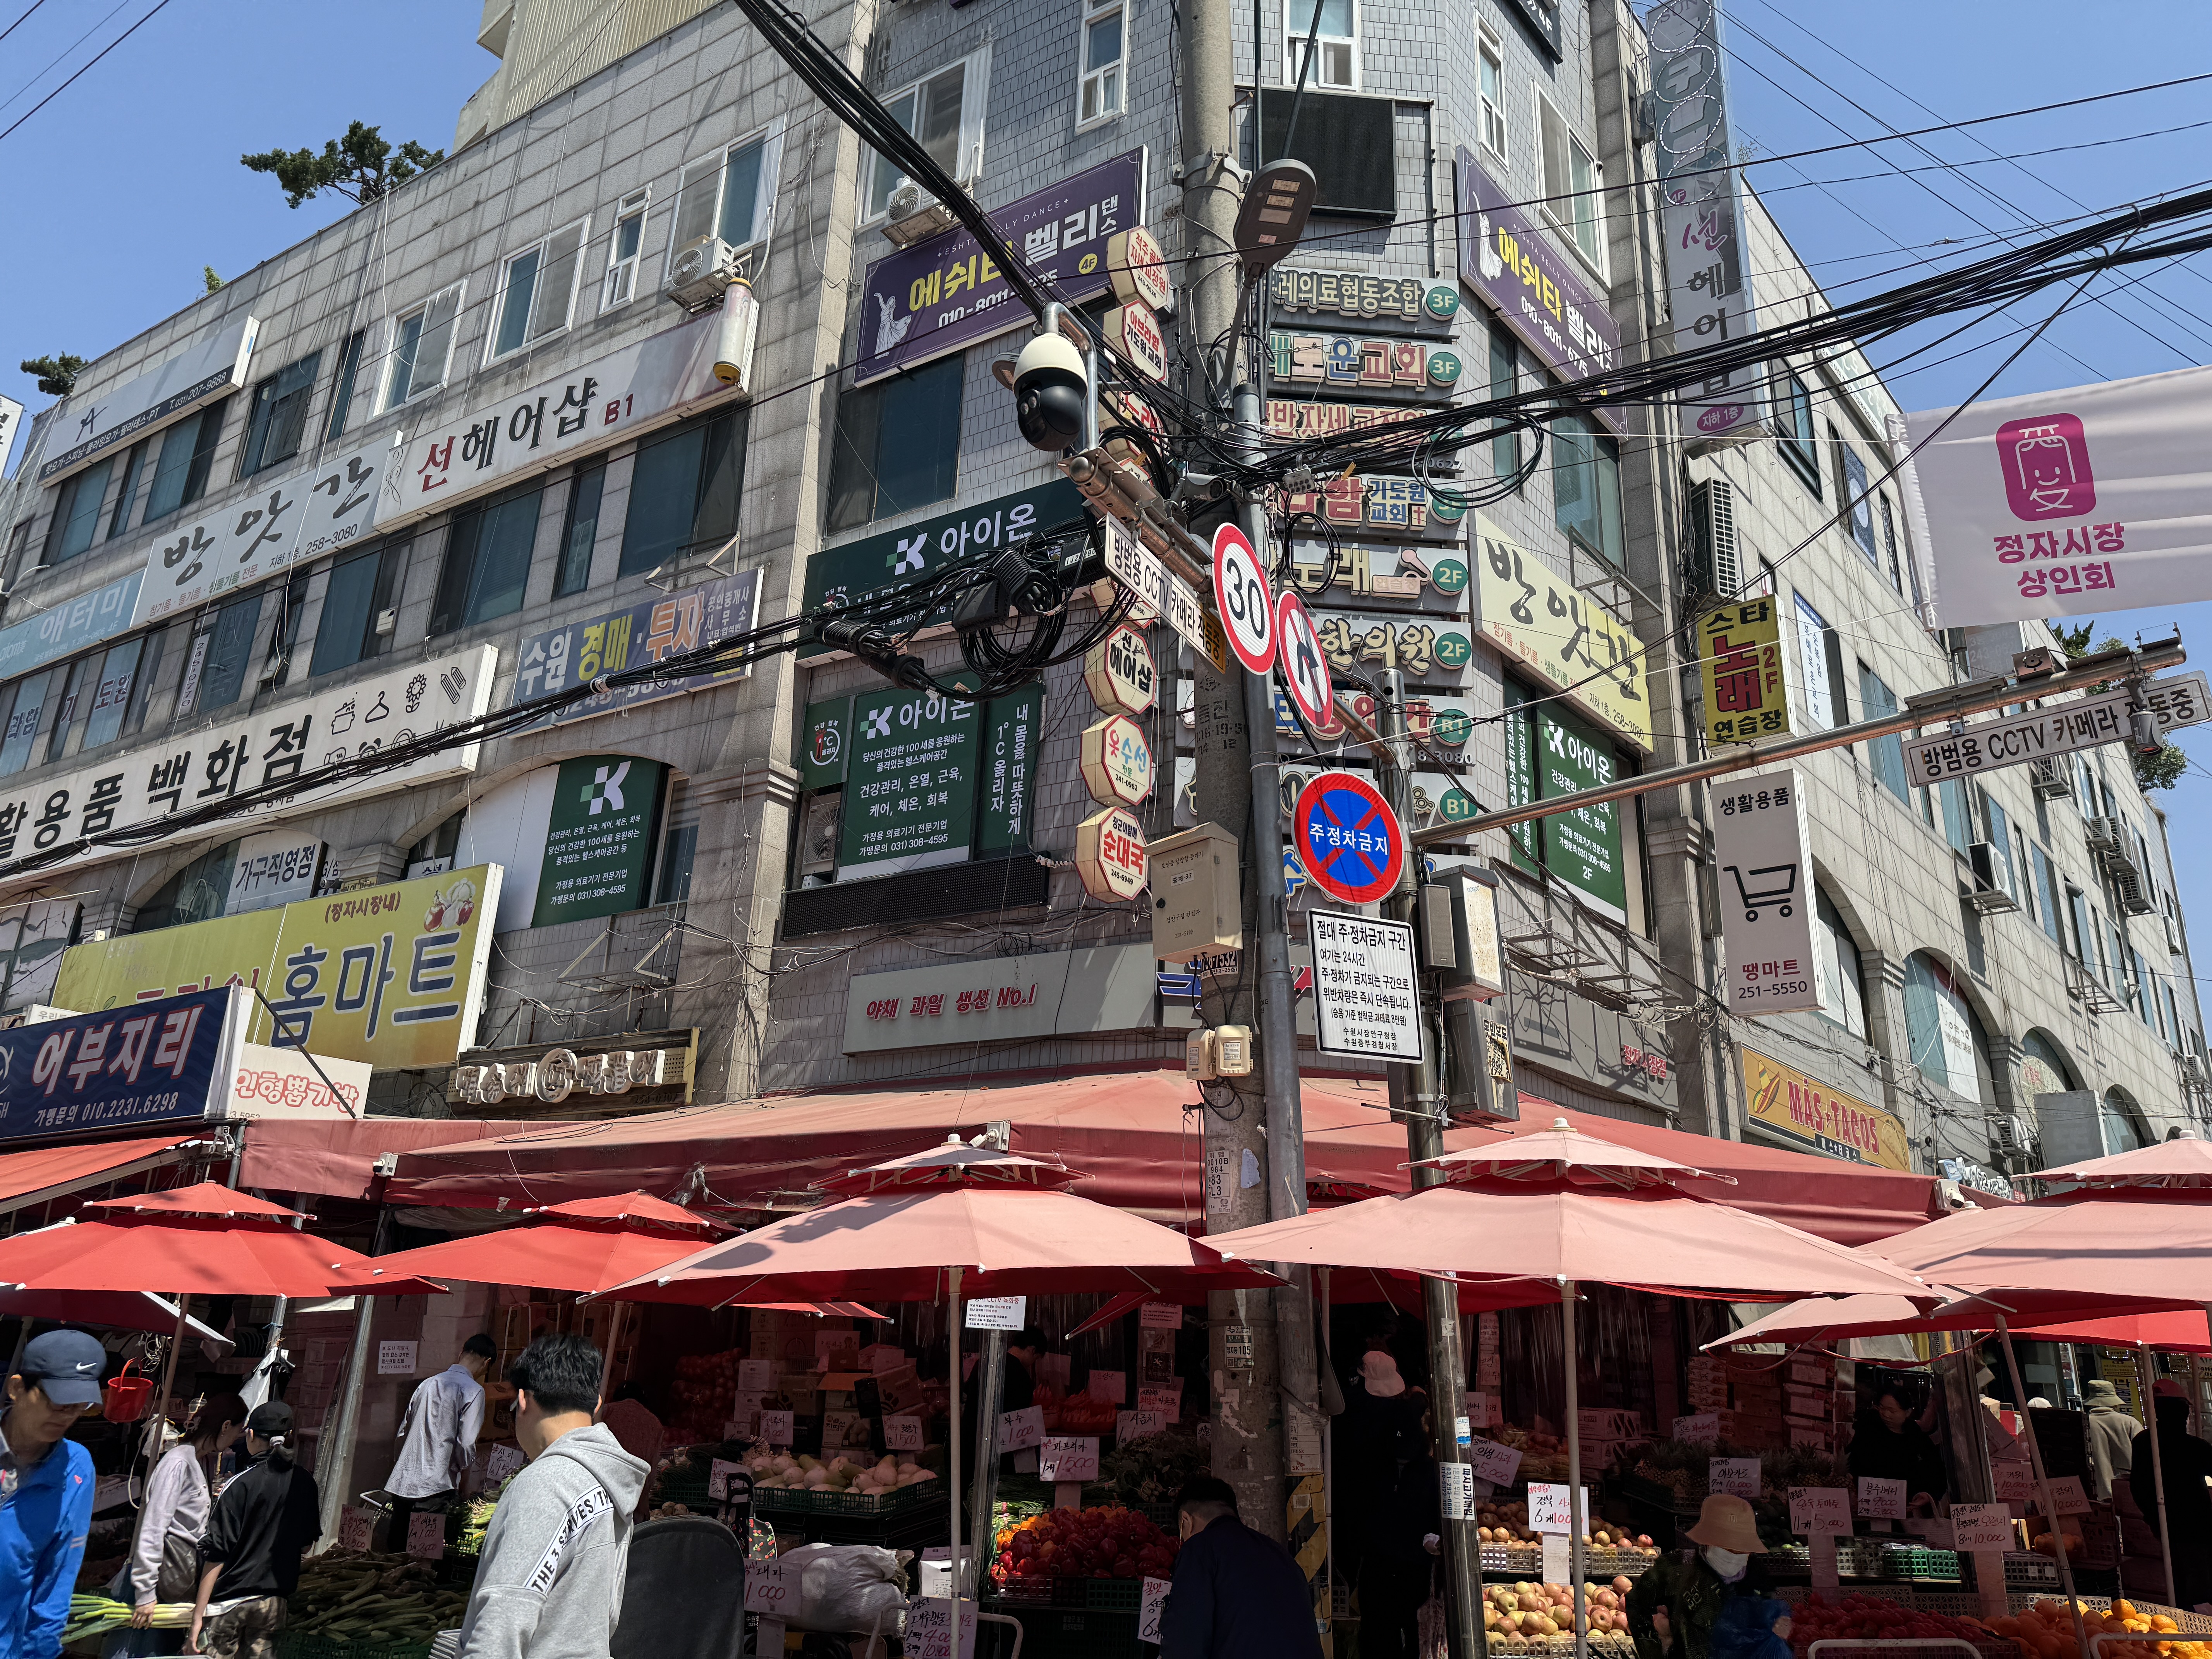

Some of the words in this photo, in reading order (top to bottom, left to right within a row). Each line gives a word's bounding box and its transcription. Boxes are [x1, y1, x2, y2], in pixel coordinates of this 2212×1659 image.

[1024, 201, 1060, 222] DANCE
[1024, 203, 1097, 266] 벨리
[1080, 257, 1096, 271] 4F
[1517, 227, 1539, 256] ESHTA
[1541, 254, 1561, 279] BELLY
[1563, 278, 1583, 303] DANCE
[1432, 294, 1454, 308] 3F
[1498, 226, 1562, 323] 에쉬타
[1566, 299, 1605, 371] 벨리
[1130, 310, 1160, 353] 아브라함
[1127, 323, 1147, 357] 기도원
[1147, 347, 1162, 372] 교회
[1432, 359, 1455, 374] 3F
[604, 393, 634, 426] B1
[1702, 410, 1720, 427] 지하
[1723, 406, 1739, 422] 1층
[1368, 479, 1425, 503] 기도원
[164, 456, 374, 586] 방앗간
[1370, 502, 1407, 522] 교회
[940, 503, 1037, 557] 아이온
[1993, 522, 2126, 564] 정자시장
[269, 553, 285, 568] 지하
[305, 524, 357, 555] 258-3080
[1439, 567, 1462, 583] 2F
[2016, 561, 2116, 599] 상인회
[150, 598, 171, 617] 참기름
[179, 586, 201, 606] 들기름
[242, 563, 258, 580] 전문
[707, 586, 749, 613] 공인중개사
[1114, 533, 1142, 586] 방범용
[1144, 564, 1169, 610] CCTV
[1171, 589, 1195, 637] 카메라
[1198, 614, 1220, 661] 작동중
[1226, 557, 1265, 639] 30
[40, 580, 130, 644] 애터미
[1485, 538, 1642, 702] 방앗간
[1705, 601, 1770, 635] 스타
[521, 632, 572, 696] 수원
[578, 613, 633, 681] 경매
[646, 591, 705, 661] 투자
[1123, 632, 1132, 653] 선
[1318, 619, 1435, 675] 한의원
[1441, 641, 1465, 656] 2F
[1110, 644, 1152, 694] 헤어샵
[1519, 641, 1539, 665] 들기름
[1544, 659, 1568, 687] 생들기름
[1712, 634, 1763, 713] 노래
[899, 697, 974, 730] 아이온
[1016, 703, 1029, 721] 내
[1589, 692, 1600, 710] 지하
[1613, 709, 1644, 741] 258-3080
[1714, 709, 1782, 740] 연습장
[862, 749, 883, 763] 당신의
[884, 745, 905, 759] 건강한
[936, 733, 965, 747] 응원하는
[1013, 724, 1027, 760] 몸을
[1108, 729, 1146, 773] 옷수선
[1920, 737, 1982, 776] 방범용
[1987, 722, 2045, 760] CCTV
[2054, 704, 2121, 745] 카메라
[147, 714, 312, 812] 백화점
[876, 758, 905, 773] 품격있는
[905, 749, 948, 767] 헬스케어공간
[1568, 736, 1612, 785] 아이온
[860, 777, 904, 799] 건강관리,
[908, 773, 933, 789] 온열,
[938, 766, 963, 782] 근육,
[991, 759, 1006, 812] 올리자
[1115, 774, 1138, 792] 241-0962
[1520, 773, 1529, 785] 100
[869, 800, 893, 818] 케어,
[898, 796, 922, 812] 체온,
[926, 791, 948, 807] 회복
[1008, 763, 1025, 835] 따뜻하게
[1447, 799, 1469, 814] B1
[1719, 787, 1790, 816] 생활용품
[550, 829, 571, 840] 건강관리,
[573, 826, 585, 836] 온열,
[587, 823, 599, 833] 근육,
[601, 820, 613, 830] 케어,
[615, 817, 628, 827] 체온,
[630, 814, 641, 824] 회복
[862, 830, 884, 844] 가정용
[886, 824, 915, 839] 의료기기
[917, 819, 948, 834] 전문기업
[1113, 816, 1138, 840] 장군이할매
[1309, 823, 1388, 856] 주정차금지
[1594, 816, 1607, 836] 회복
[548, 843, 567, 855] 당신의
[568, 839, 586, 850] 건강한
[588, 833, 613, 846] 100세를
[615, 829, 640, 842] 응원하는
[556, 854, 579, 866] 품격있는
[582, 845, 619, 861] 헬스케어공간
[621, 844, 627, 854] 등
[859, 844, 888, 858] 가맹문의
[1103, 830, 1144, 876] 순대국
[1559, 823, 1573, 840] 가정용
[1573, 830, 1592, 850] 의료기기
[1592, 841, 1609, 860] 전문기업
[1559, 837, 1577, 859] 가맹문의
[235, 843, 316, 891] 가구직영점
[555, 878, 574, 890] 가정용
[575, 874, 601, 887] 의료기기
[602, 869, 628, 882] 전문기업
[1111, 869, 1134, 885] 245-6949
[1582, 865, 1593, 880] 2F
[325, 891, 401, 924] (정자시장내)
[550, 893, 575, 905] 가맹문의
[1317, 920, 1336, 941] 절대
[1338, 923, 1386, 948] 주·정차금지
[1388, 931, 1406, 951] 구간
[1320, 948, 1341, 963] 여기는
[1343, 950, 1365, 966] 24시간
[1742, 958, 1801, 982] 땡마트
[268, 929, 463, 1050] 홈마트
[1321, 967, 1352, 984] 주·정차가
[1353, 971, 1381, 988] 금지되는
[1382, 975, 1410, 990] 구간으로
[1738, 980, 1808, 1000] 251-5550
[866, 997, 902, 1020] 야채
[909, 993, 947, 1016] 과일
[955, 988, 992, 1013] 생선
[996, 983, 1039, 1008] No.1
[1323, 986, 1358, 1004] 위반차량은
[1360, 991, 1374, 1006] 즉시
[1375, 994, 1411, 1011] 단속됩니다.
[1331, 1007, 1344, 1019] (승용
[1345, 1009, 1356, 1020] 기준
[1391, 1014, 1407, 1027] 8만원)
[32, 1003, 206, 1097] 어부지리
[1623, 1044, 1667, 1079] 정자시장점
[235, 1068, 359, 1114] 인형뽑기방
[34, 1104, 79, 1127] 가맹문의
[82, 1091, 179, 1121] 010.2231.6298
[1829, 1098, 1879, 1156] TACOS
[1239, 1345, 1251, 1355] 105
[1005, 1412, 1024, 1426] 부추
[1130, 1412, 1156, 1426] 시금치
[1052, 1438, 1087, 1453] 파프리카
[1475, 1446, 1495, 1460] 의성
[1057, 1455, 1094, 1473] 1.500
[1718, 1468, 1752, 1479] 아보카도
[1725, 1480, 1752, 1488] 10.000
[1865, 1482, 1897, 1496] 블루베리
[1536, 1495, 1553, 1507] 경북
[1814, 1513, 1844, 1530] 5.000
[1981, 1515, 2006, 1527] 오렌지
[1975, 1533, 2006, 1544] 10.000
[531, 1561, 556, 1591] THE
[551, 1550, 560, 1563] 3
[756, 1565, 788, 1581] 대파
